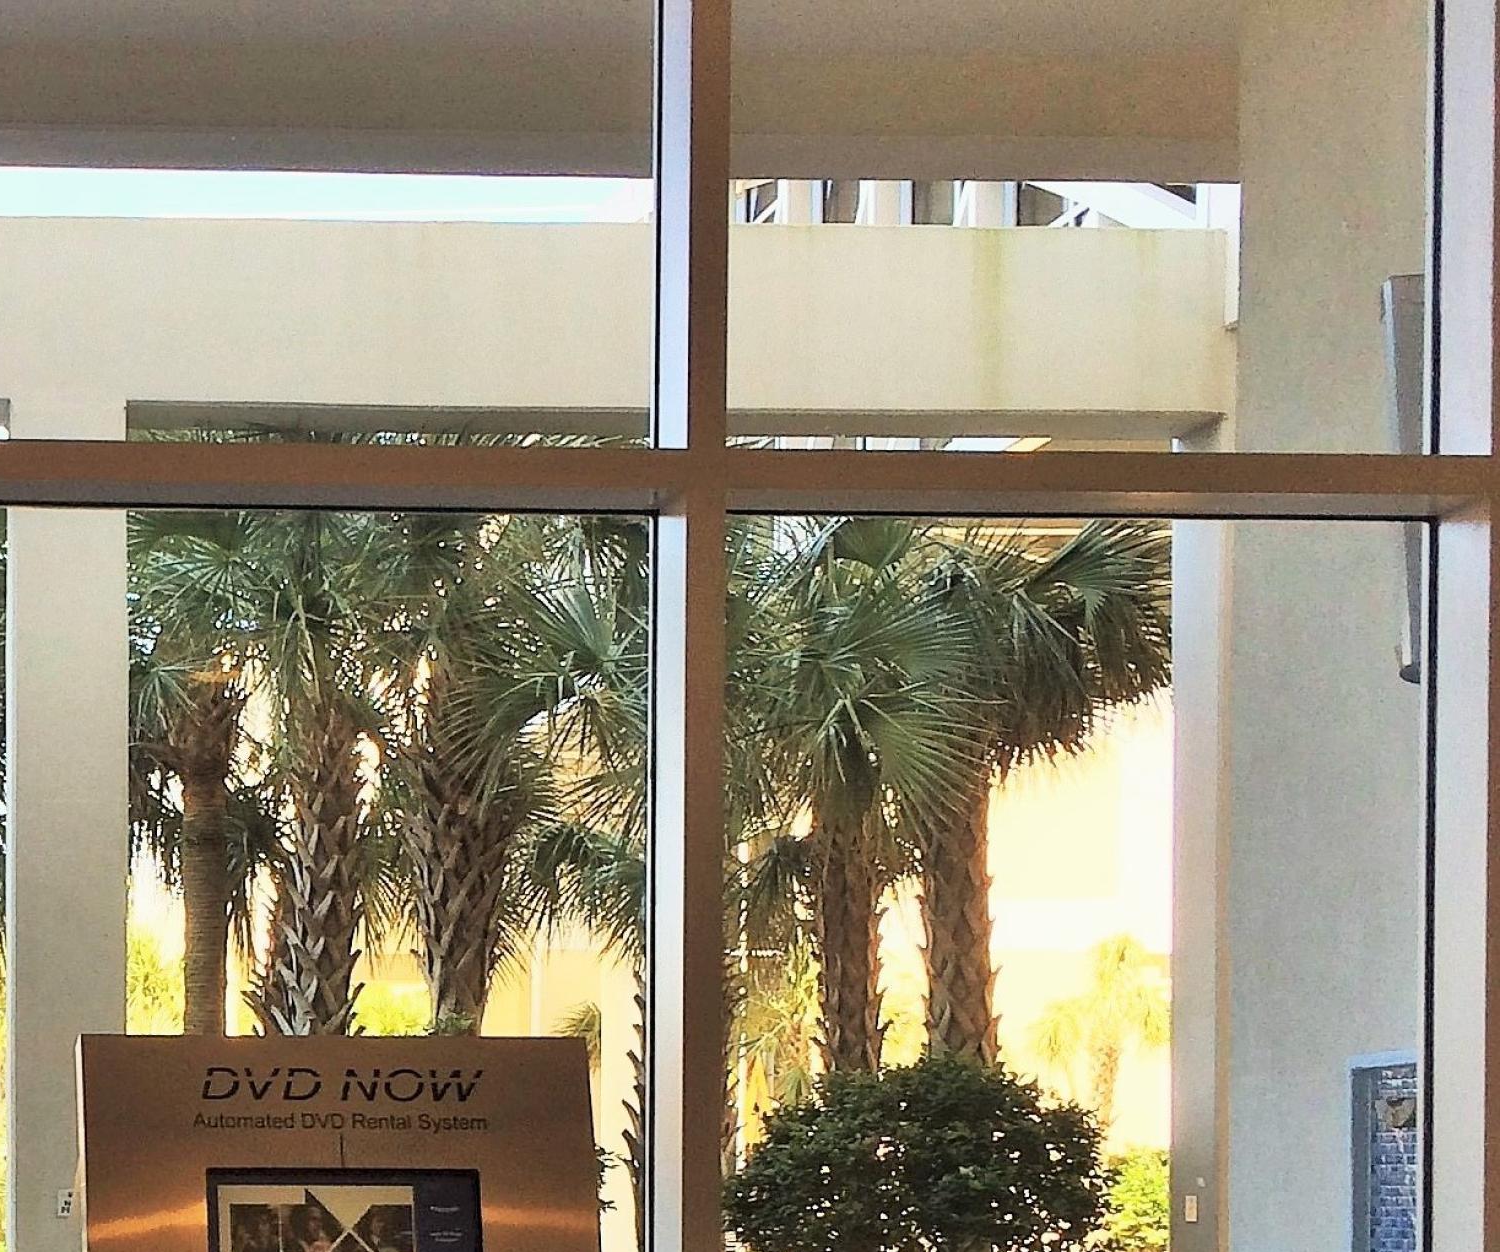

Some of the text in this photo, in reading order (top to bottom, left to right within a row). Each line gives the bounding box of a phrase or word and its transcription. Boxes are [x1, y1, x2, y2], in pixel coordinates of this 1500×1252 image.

[202, 1066, 483, 1101] DVD NOW
[193, 1112, 487, 1135] Automated DVD Rental System
